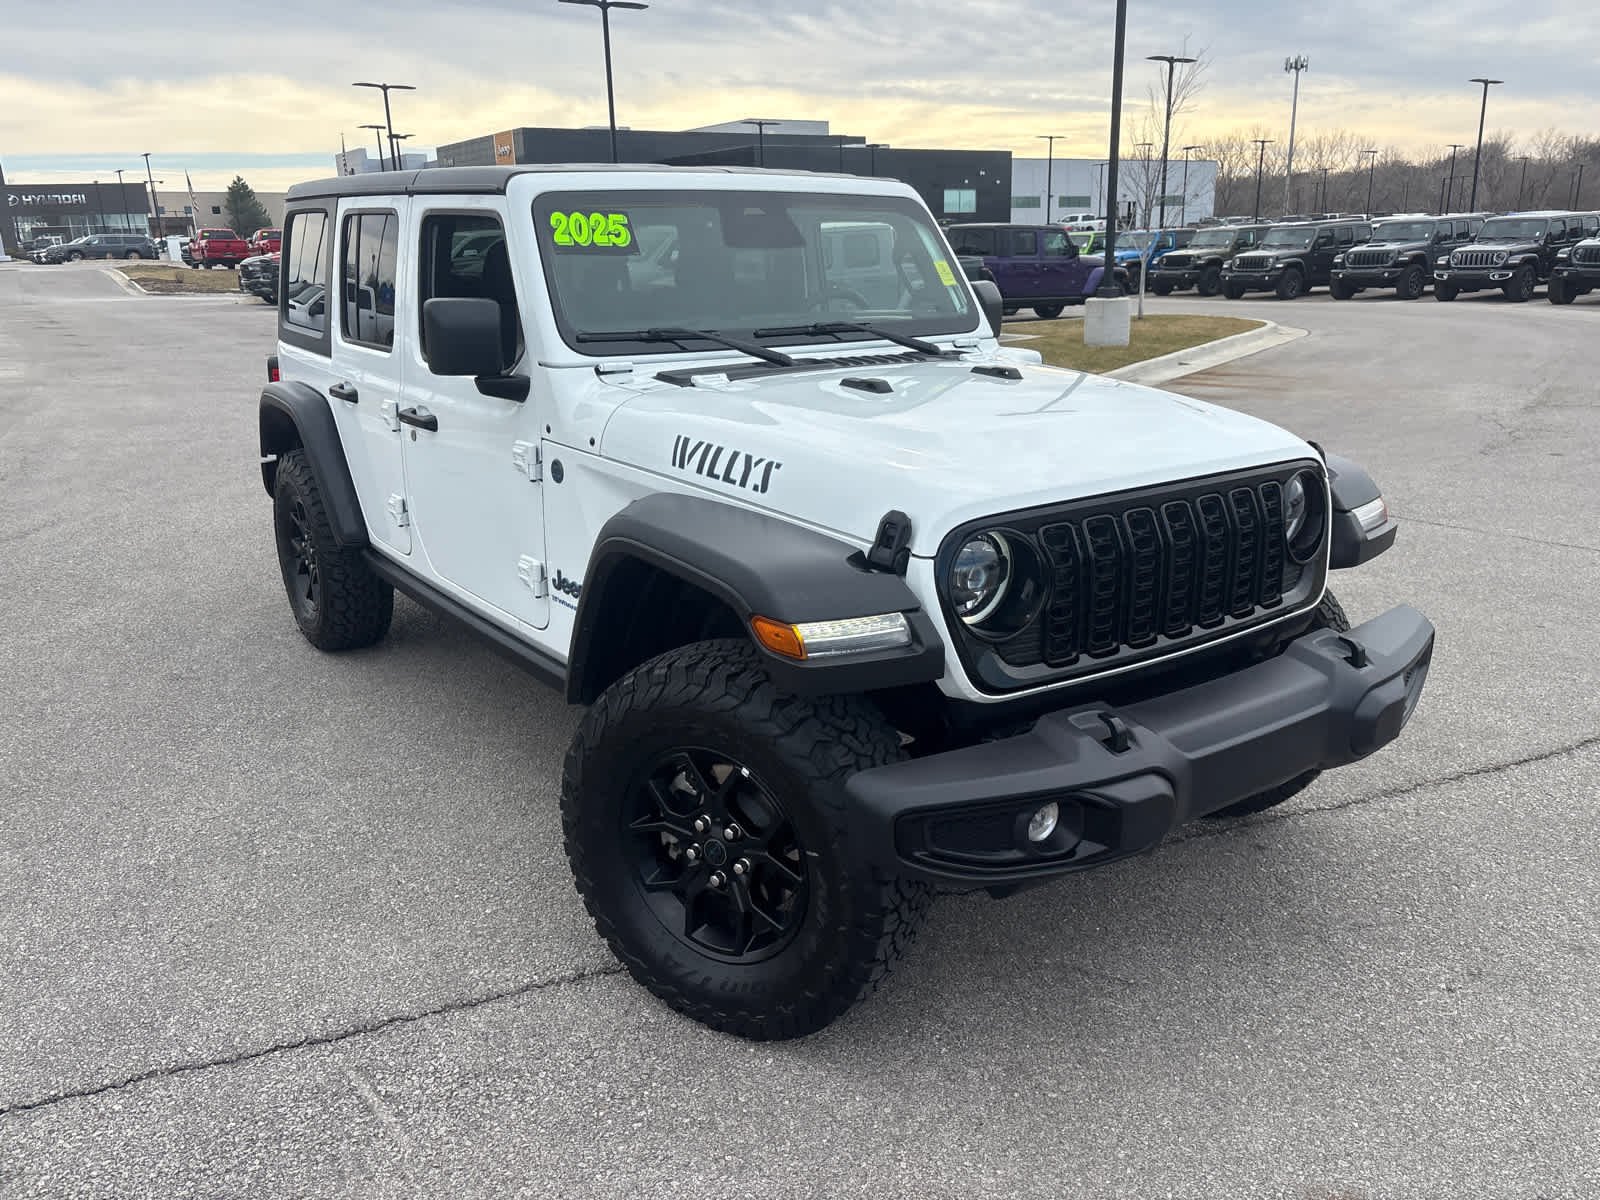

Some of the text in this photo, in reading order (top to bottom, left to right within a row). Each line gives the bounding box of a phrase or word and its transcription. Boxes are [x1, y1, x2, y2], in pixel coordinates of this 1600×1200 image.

[550, 211, 632, 247] 2025
[671, 434, 783, 494] WILLYS
[551, 569, 582, 599] Jee
